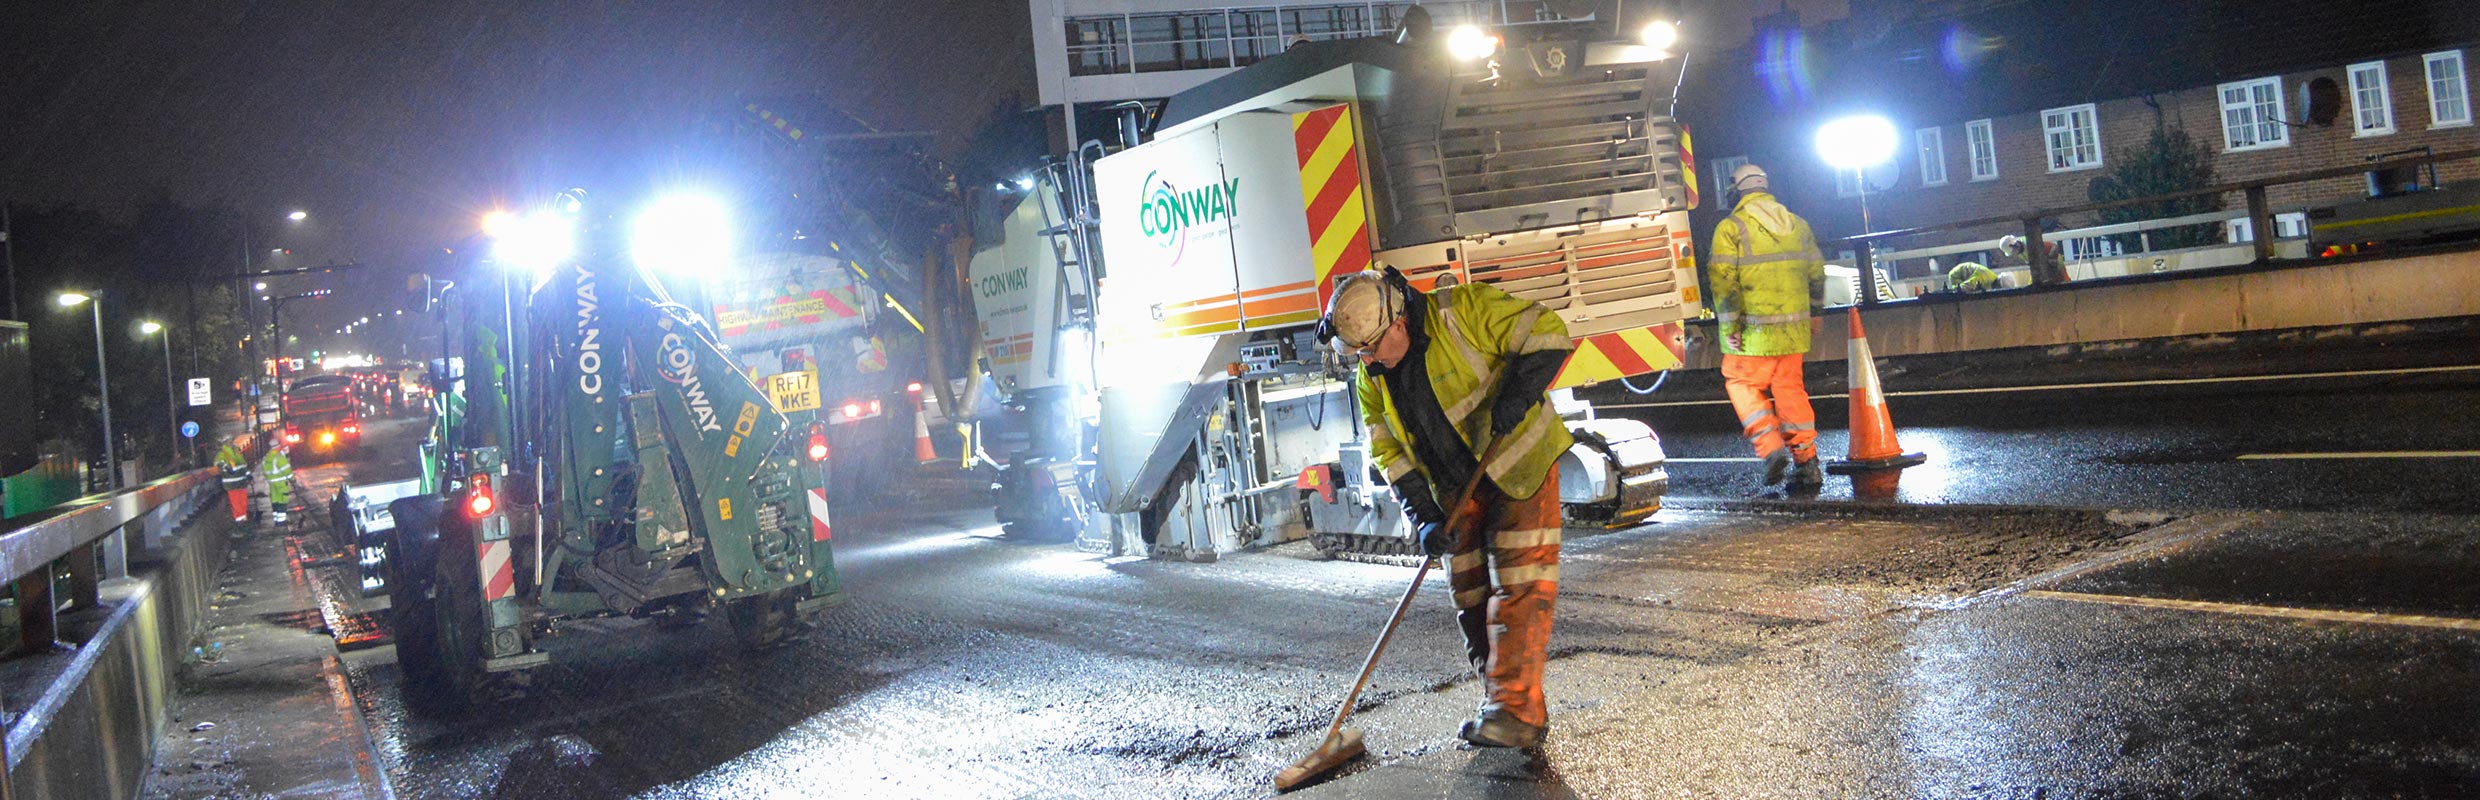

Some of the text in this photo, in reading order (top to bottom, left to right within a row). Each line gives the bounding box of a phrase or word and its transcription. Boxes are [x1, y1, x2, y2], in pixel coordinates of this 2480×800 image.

[1140, 177, 1239, 238] CONWAY
[982, 266, 1028, 298] CONWAY
[718, 300, 825, 326] HIGHWAY MAINTENANCE
[575, 264, 602, 395] CONWAY
[662, 332, 722, 432] CONWAY
[776, 374, 811, 393] RF17
[780, 392, 812, 410] WKE
